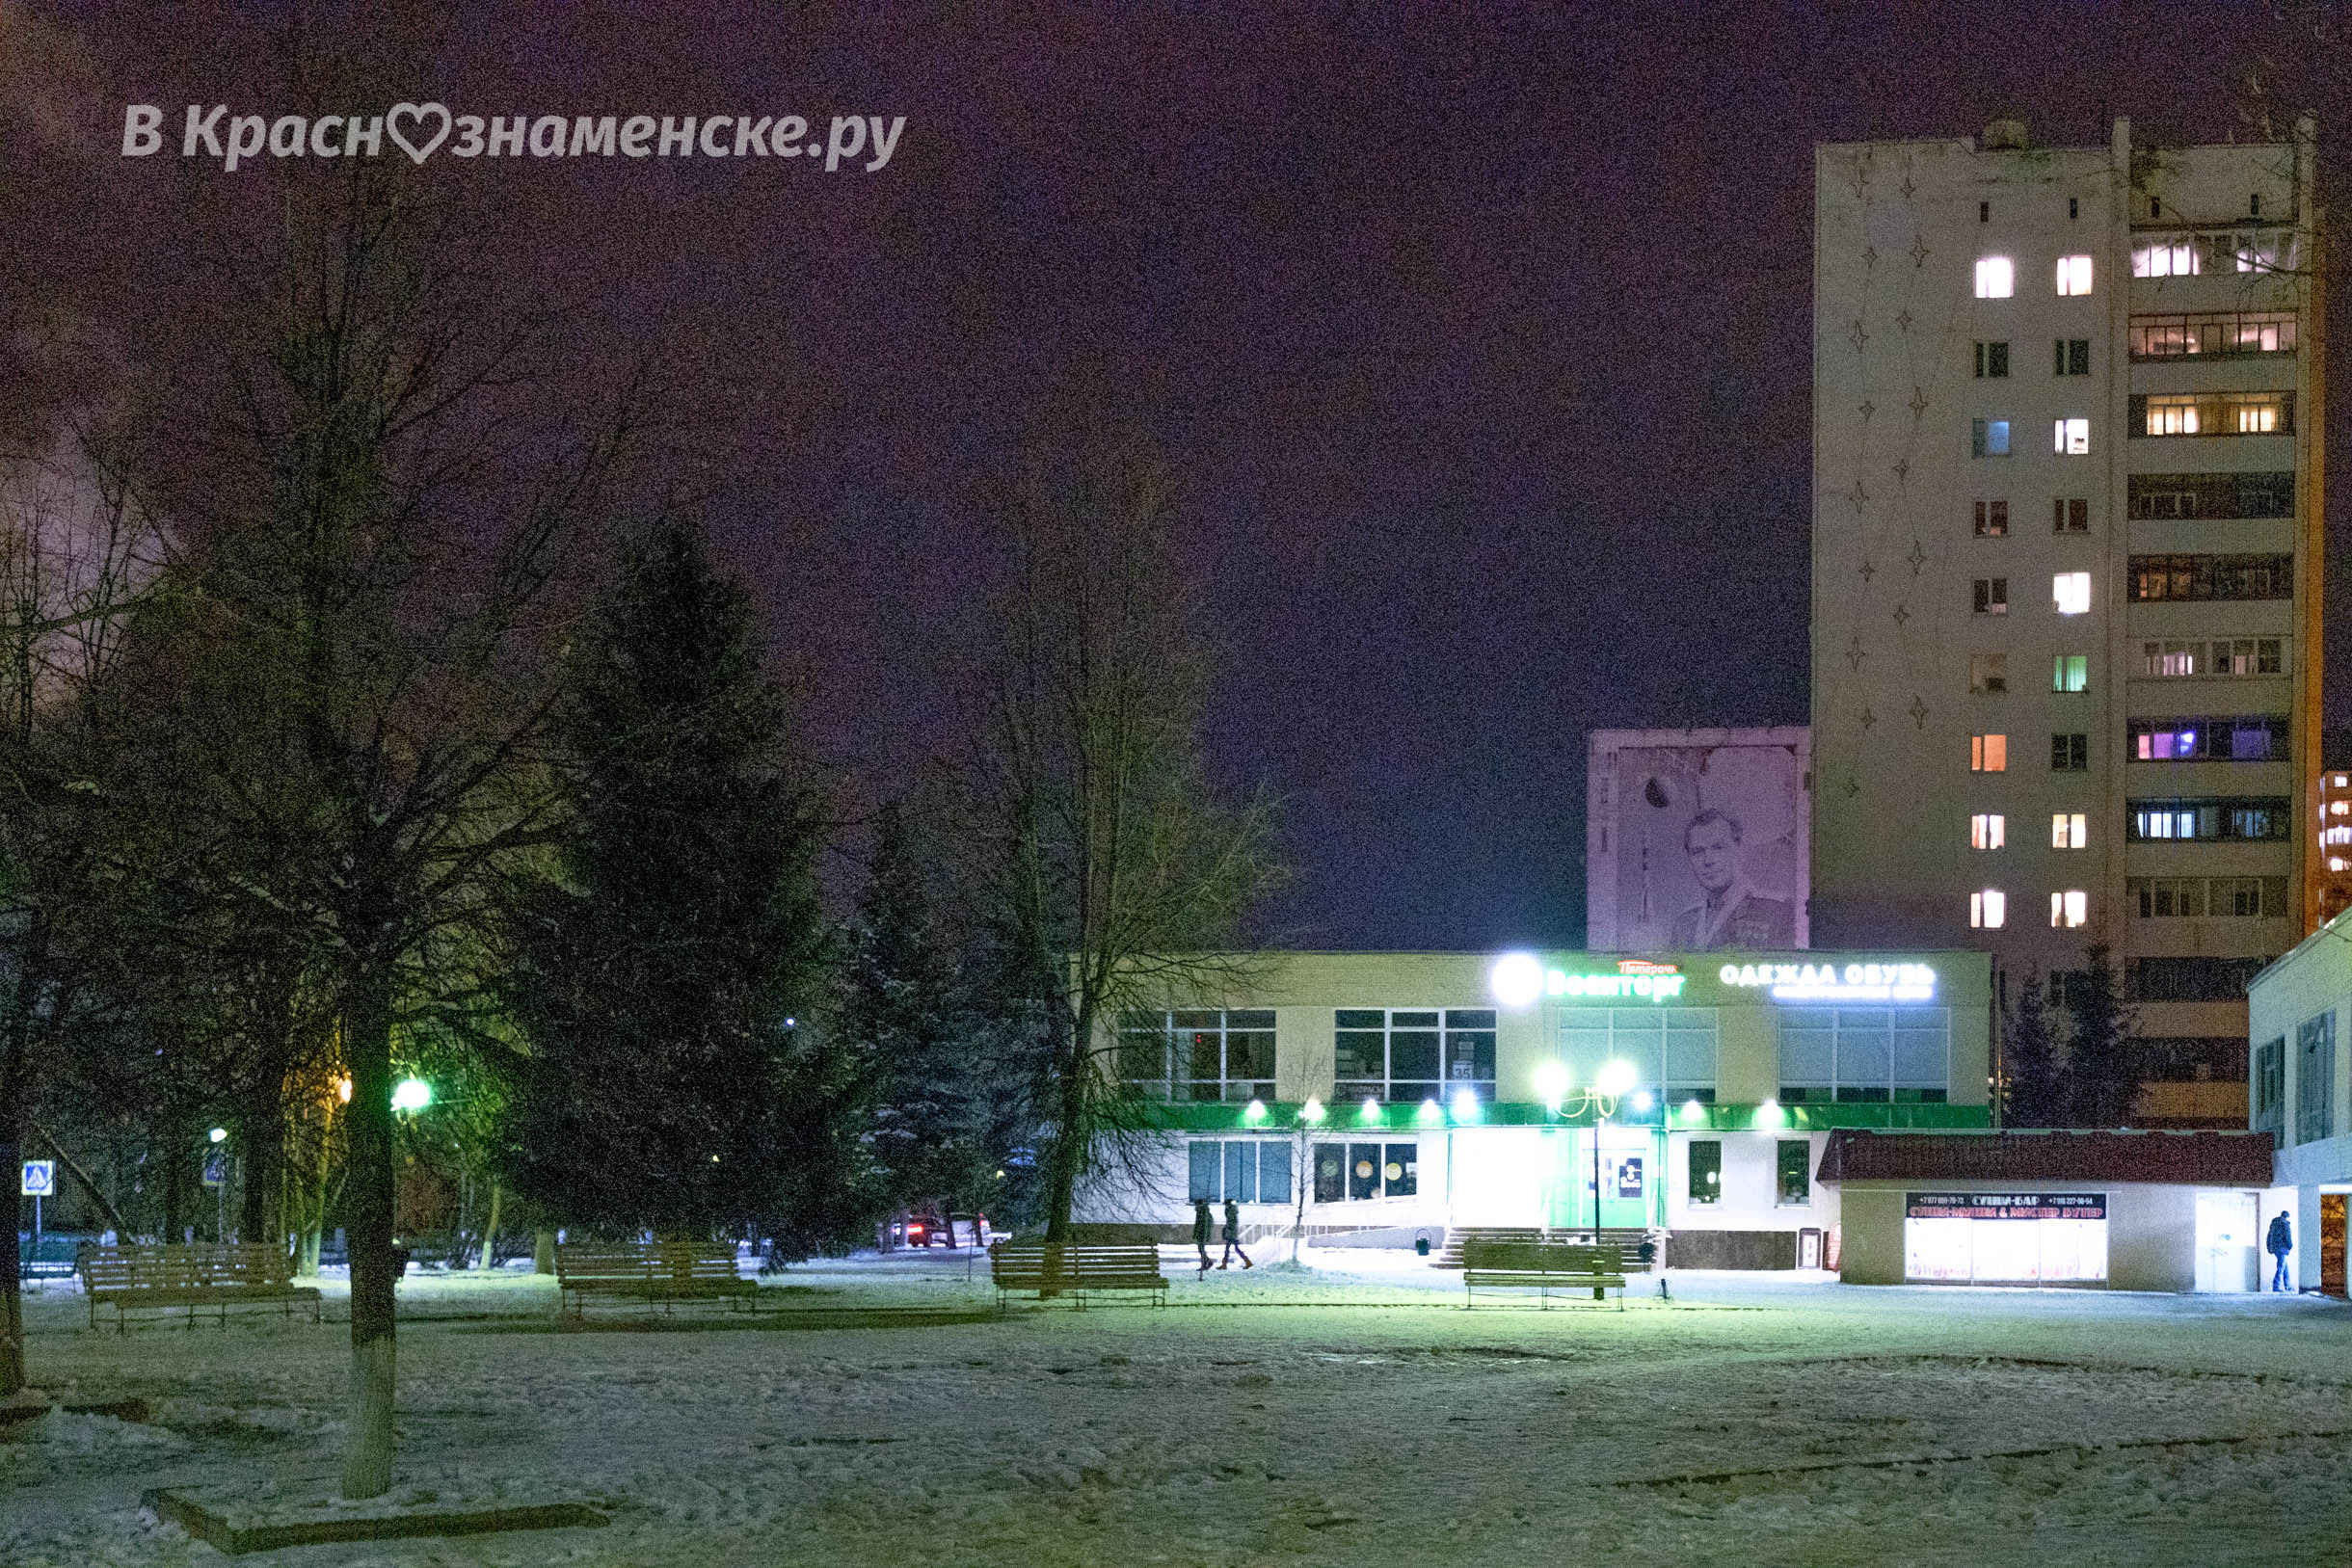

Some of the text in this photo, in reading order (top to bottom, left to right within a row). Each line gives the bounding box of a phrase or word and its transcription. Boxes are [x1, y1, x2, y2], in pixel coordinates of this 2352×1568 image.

[1720, 964, 1937, 986] ОДЕЖДА ОБУВЬ
[1971, 1195, 2041, 1206] СУШИ-БАР
